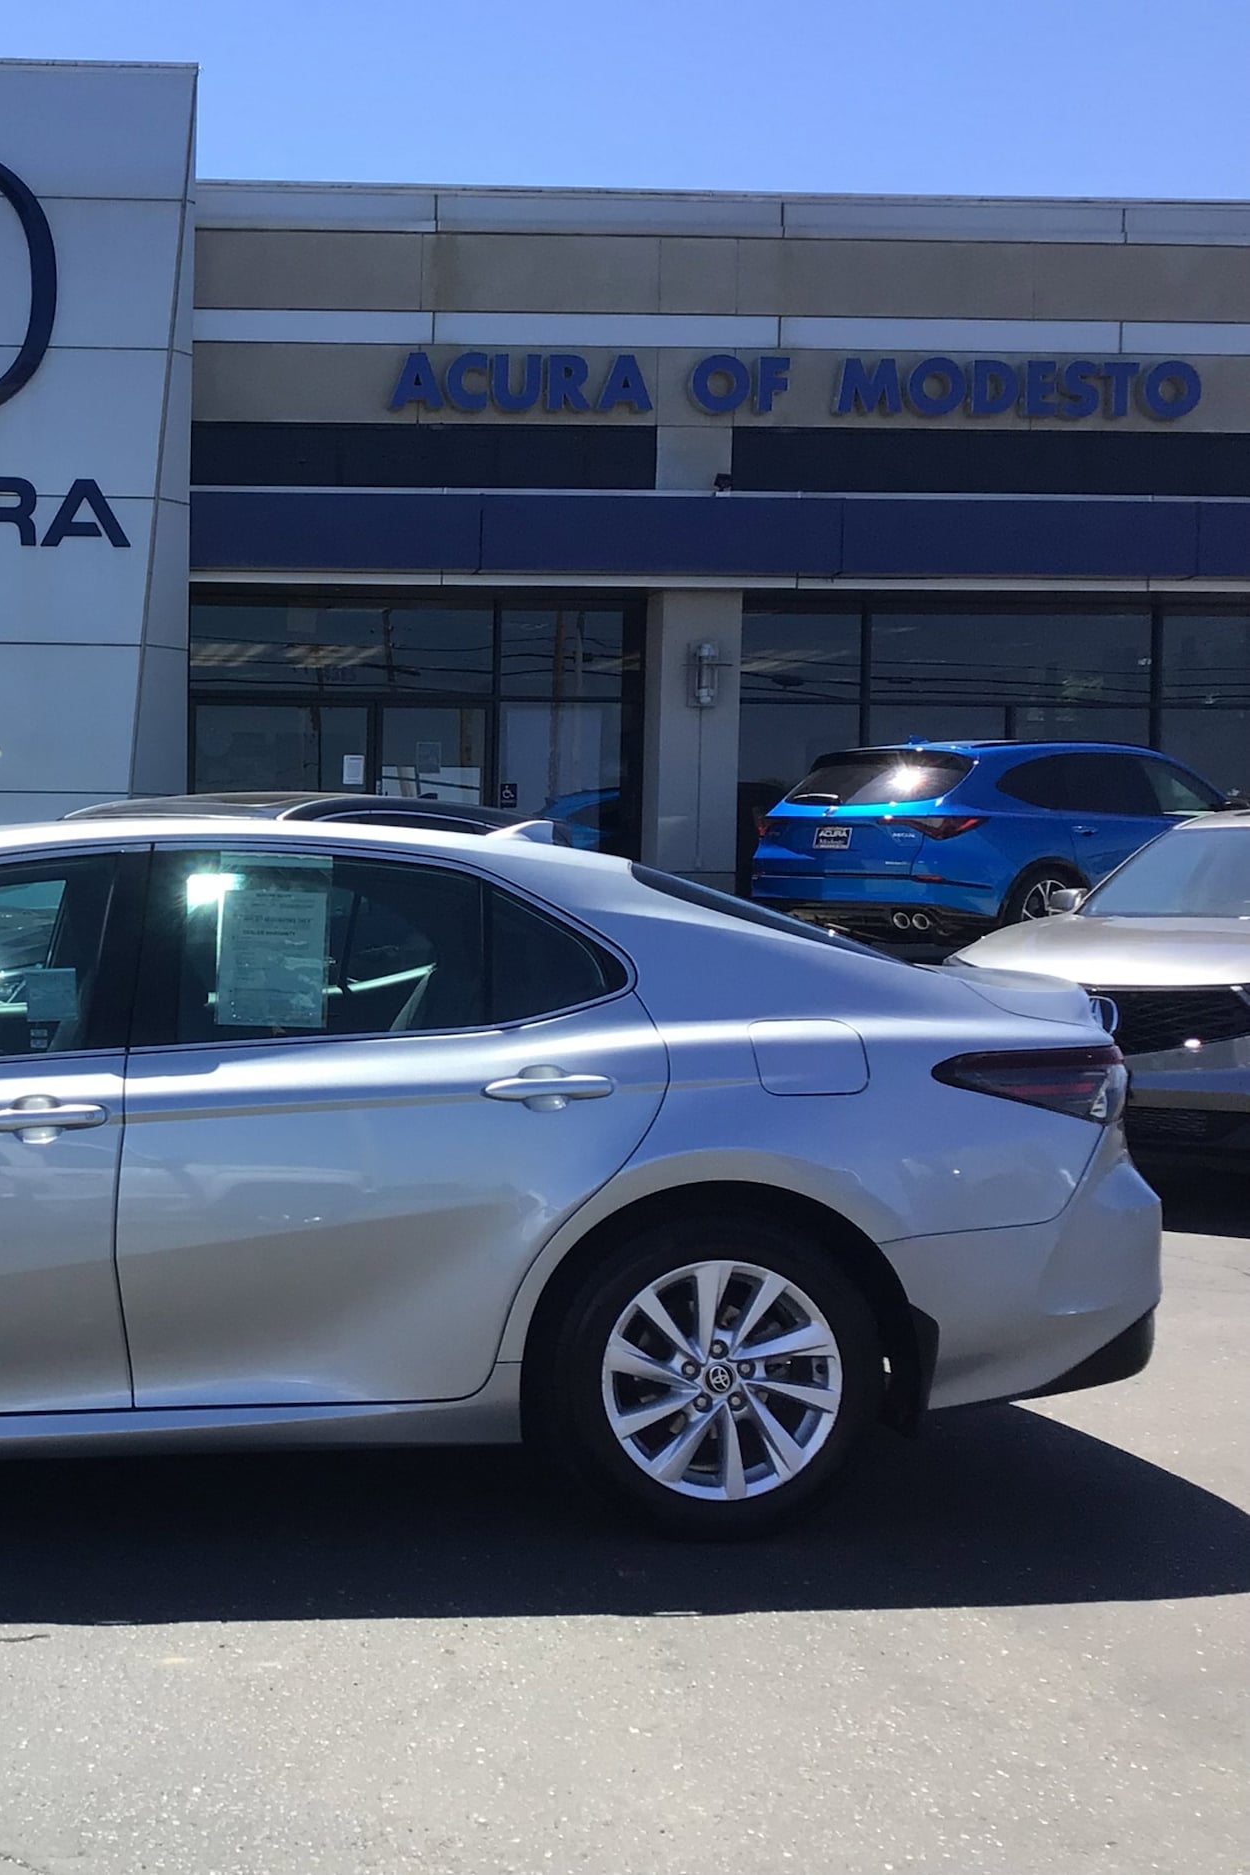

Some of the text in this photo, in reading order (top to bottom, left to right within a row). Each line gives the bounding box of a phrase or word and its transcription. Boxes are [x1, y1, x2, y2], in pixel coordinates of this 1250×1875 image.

[390, 352, 1202, 418] ACURA OF MODESTO
